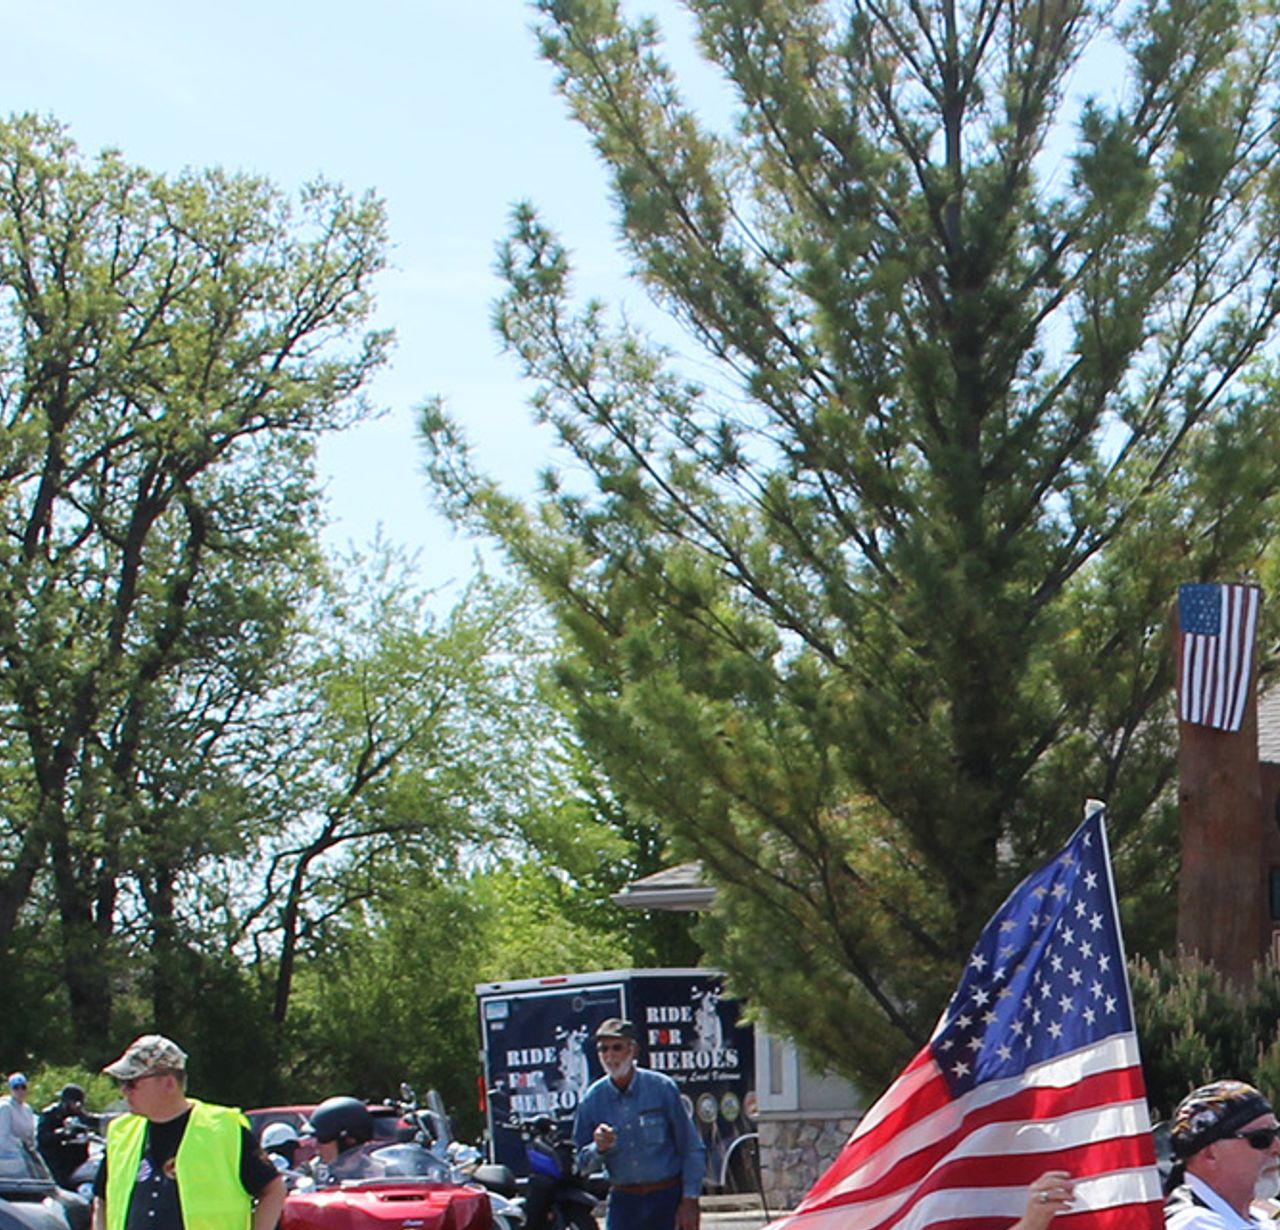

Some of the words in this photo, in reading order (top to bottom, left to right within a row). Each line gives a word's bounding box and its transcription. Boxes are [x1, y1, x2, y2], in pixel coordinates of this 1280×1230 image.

[646, 1006, 693, 1023] RIDE
[648, 1028, 682, 1046] FOR
[506, 1046, 557, 1066] RIDE
[649, 1048, 739, 1070] HEROES
[510, 1090, 576, 1112] HERO
